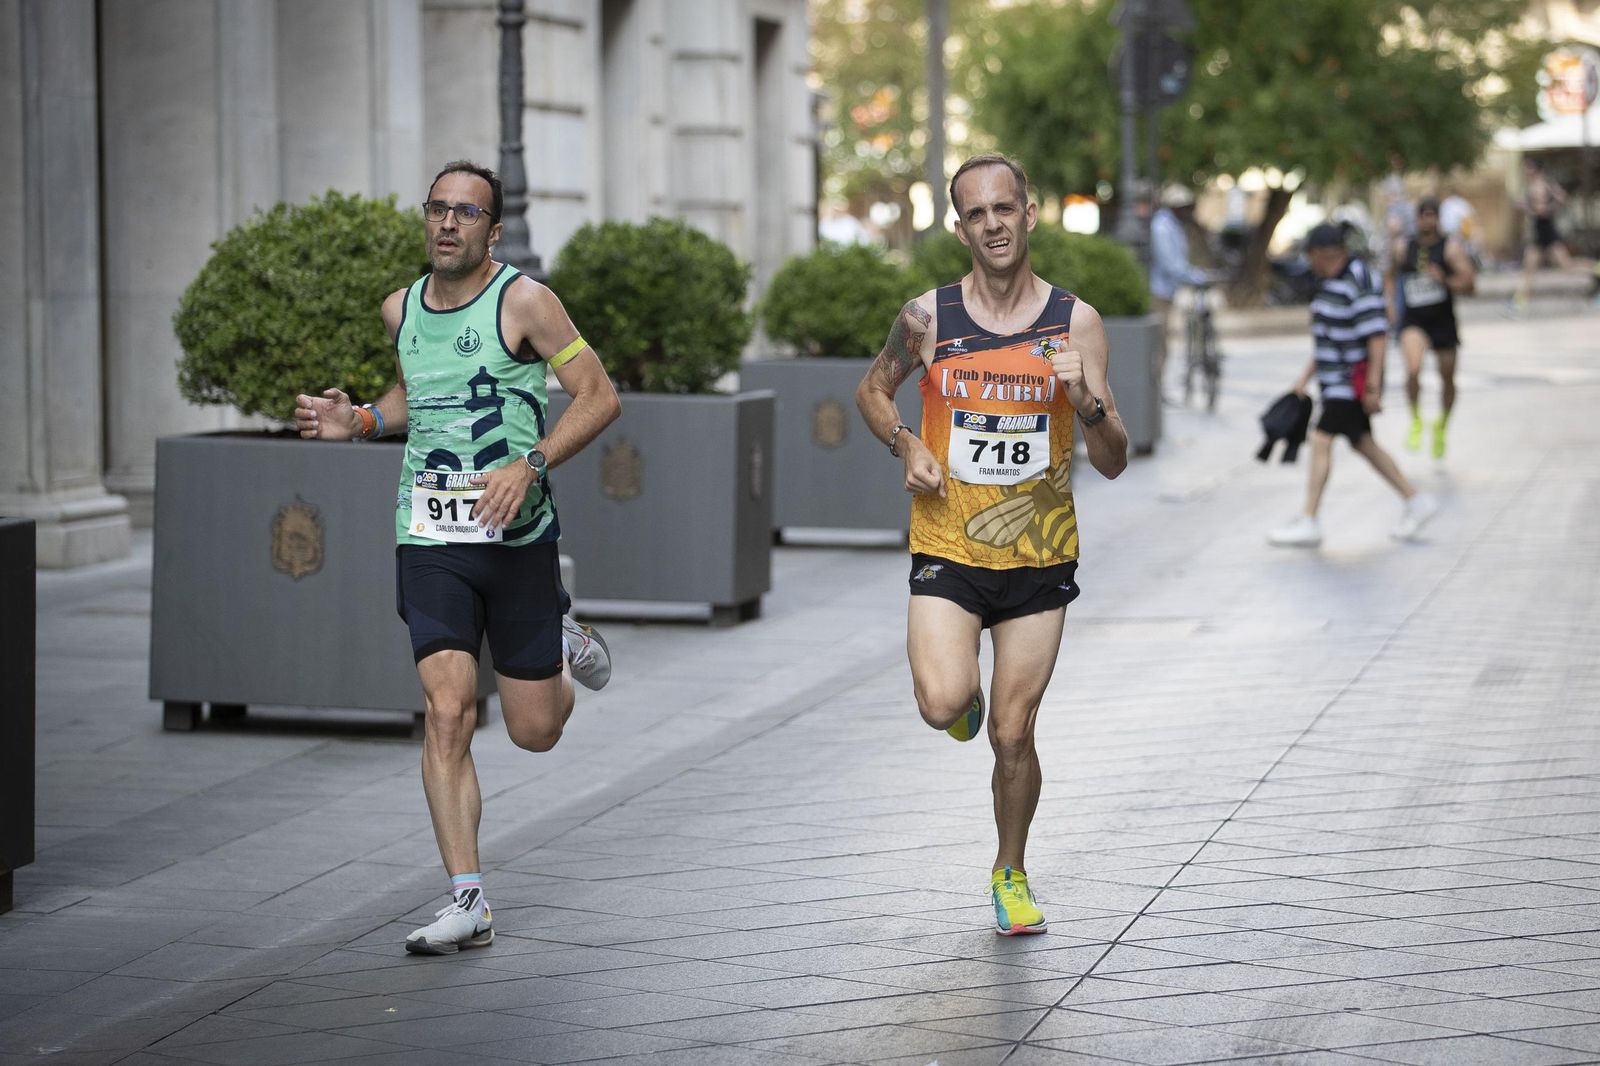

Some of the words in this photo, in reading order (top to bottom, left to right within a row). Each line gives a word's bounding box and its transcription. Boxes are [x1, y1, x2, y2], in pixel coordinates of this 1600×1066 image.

[941, 368, 969, 398] LA
[980, 375, 1057, 403] ZUBIA
[953, 368, 979, 381] Club
[982, 371, 1045, 386] Deportivo
[996, 415, 1039, 430] GRANADA
[968, 438, 1030, 465] 718
[979, 467, 995, 476] FRAN
[996, 467, 1021, 477] MARTOS
[427, 497, 480, 522] 917
[435, 524, 455, 533] CARLOS
[455, 525, 479, 533] RODRIGO
